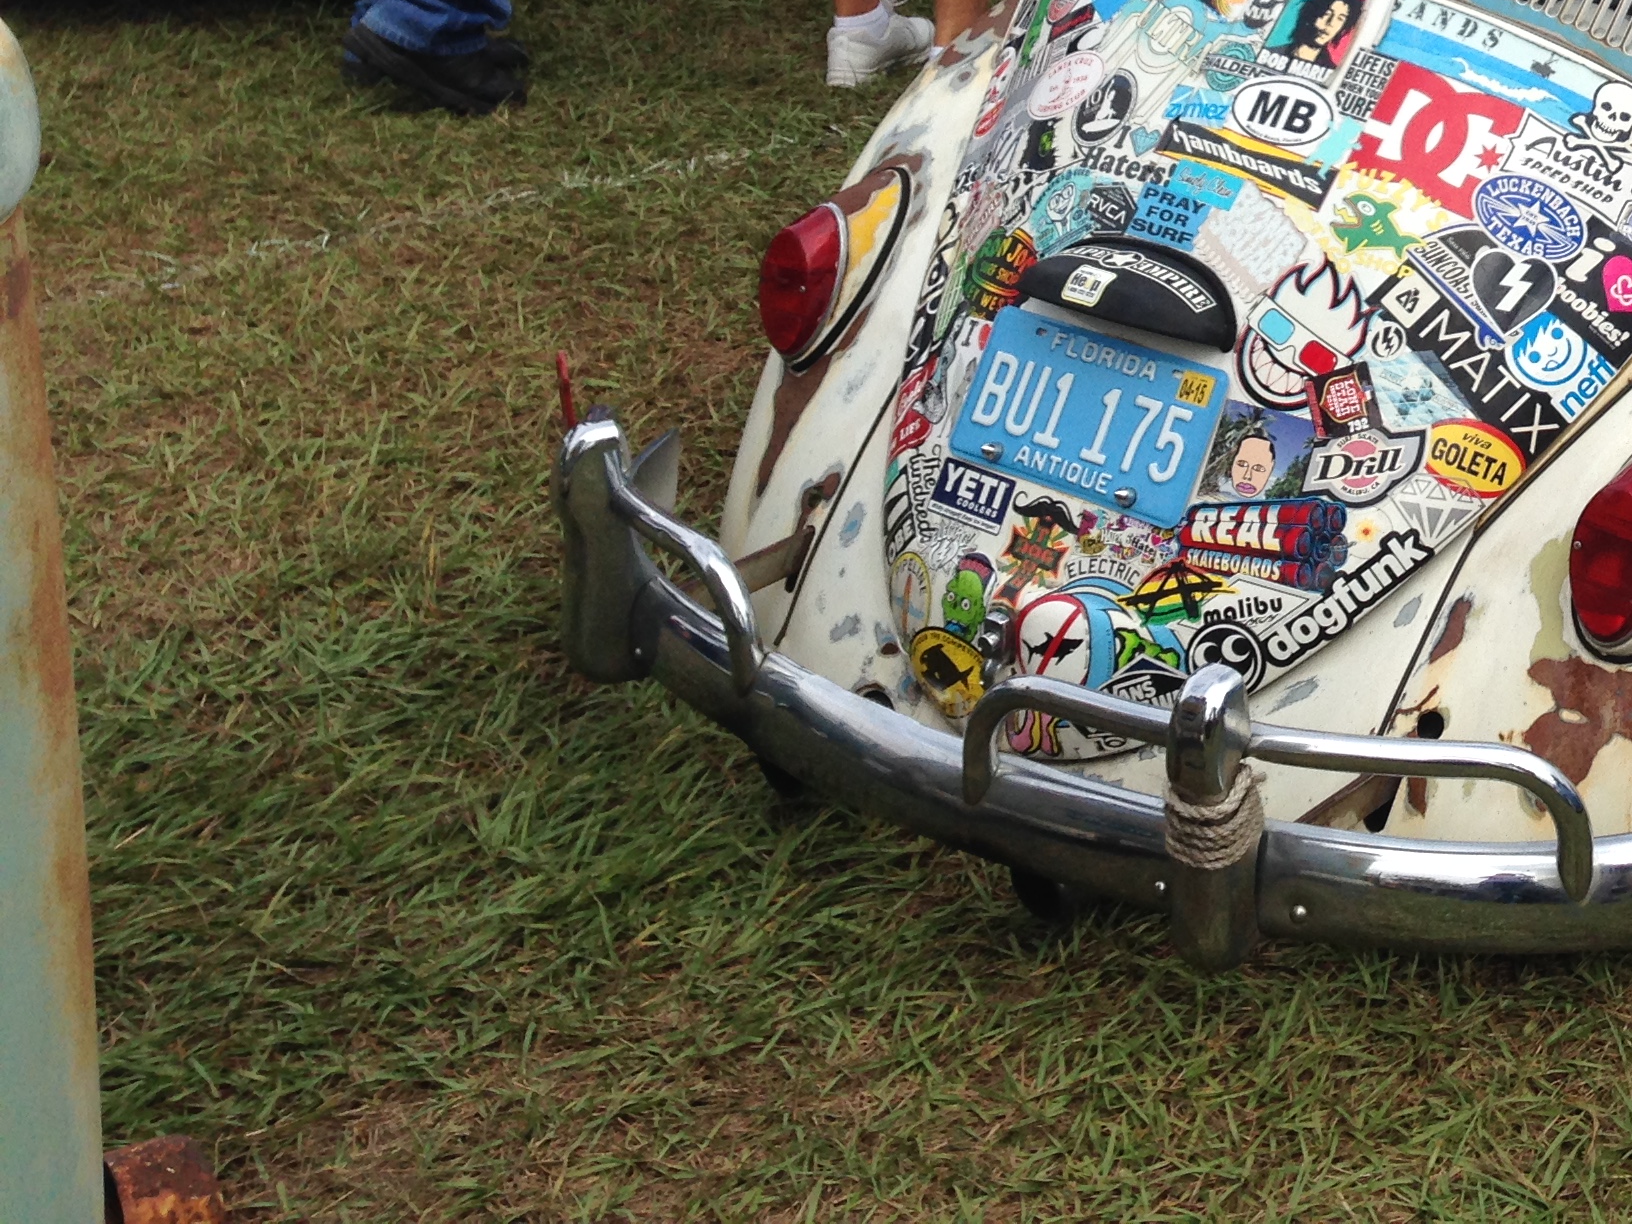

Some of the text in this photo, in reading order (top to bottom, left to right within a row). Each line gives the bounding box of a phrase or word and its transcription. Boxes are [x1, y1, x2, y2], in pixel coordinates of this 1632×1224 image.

[1256, 49, 1289, 70] BOB
[1350, 51, 1396, 78] LIFE IS
[1339, 80, 1383, 101] WHEN YOU
[1343, 66, 1388, 95] BETTER
[1246, 89, 1318, 135] MB
[1335, 89, 1378, 118] SURF
[1113, 125, 1132, 149] I
[1079, 146, 1178, 188] Haters!
[1520, 156, 1614, 204] SPEED SHOP
[1525, 135, 1624, 192] Austin
[1143, 187, 1207, 215] PRAY
[1146, 205, 1190, 228] FOR
[1486, 177, 1582, 238] LUCKENBACH
[1130, 217, 1194, 245] SURF
[1486, 216, 1546, 257] TEXAS
[1133, 258, 1211, 309] EMPIRE
[1556, 277, 1631, 348] boobies!
[1051, 331, 1159, 382] FLORIDA
[1178, 377, 1209, 405] 04-15
[1418, 308, 1561, 455] MATIX
[1559, 352, 1617, 419] neff
[970, 350, 1194, 483] BU1 175
[1346, 417, 1370, 433] 792
[1461, 431, 1493, 450] viva
[1013, 445, 1114, 495] ANTIQUE
[1313, 447, 1403, 482] Drill
[1430, 436, 1511, 487] GOLETA
[942, 462, 1010, 511] YETI
[955, 496, 999, 519] COOLERS
[1189, 504, 1283, 552] REAL
[1066, 558, 1141, 587] ELECTRIC
[1184, 548, 1283, 581] SKATEBOARDS
[1202, 595, 1284, 625] malibu
[1266, 534, 1428, 661] dogfunk
